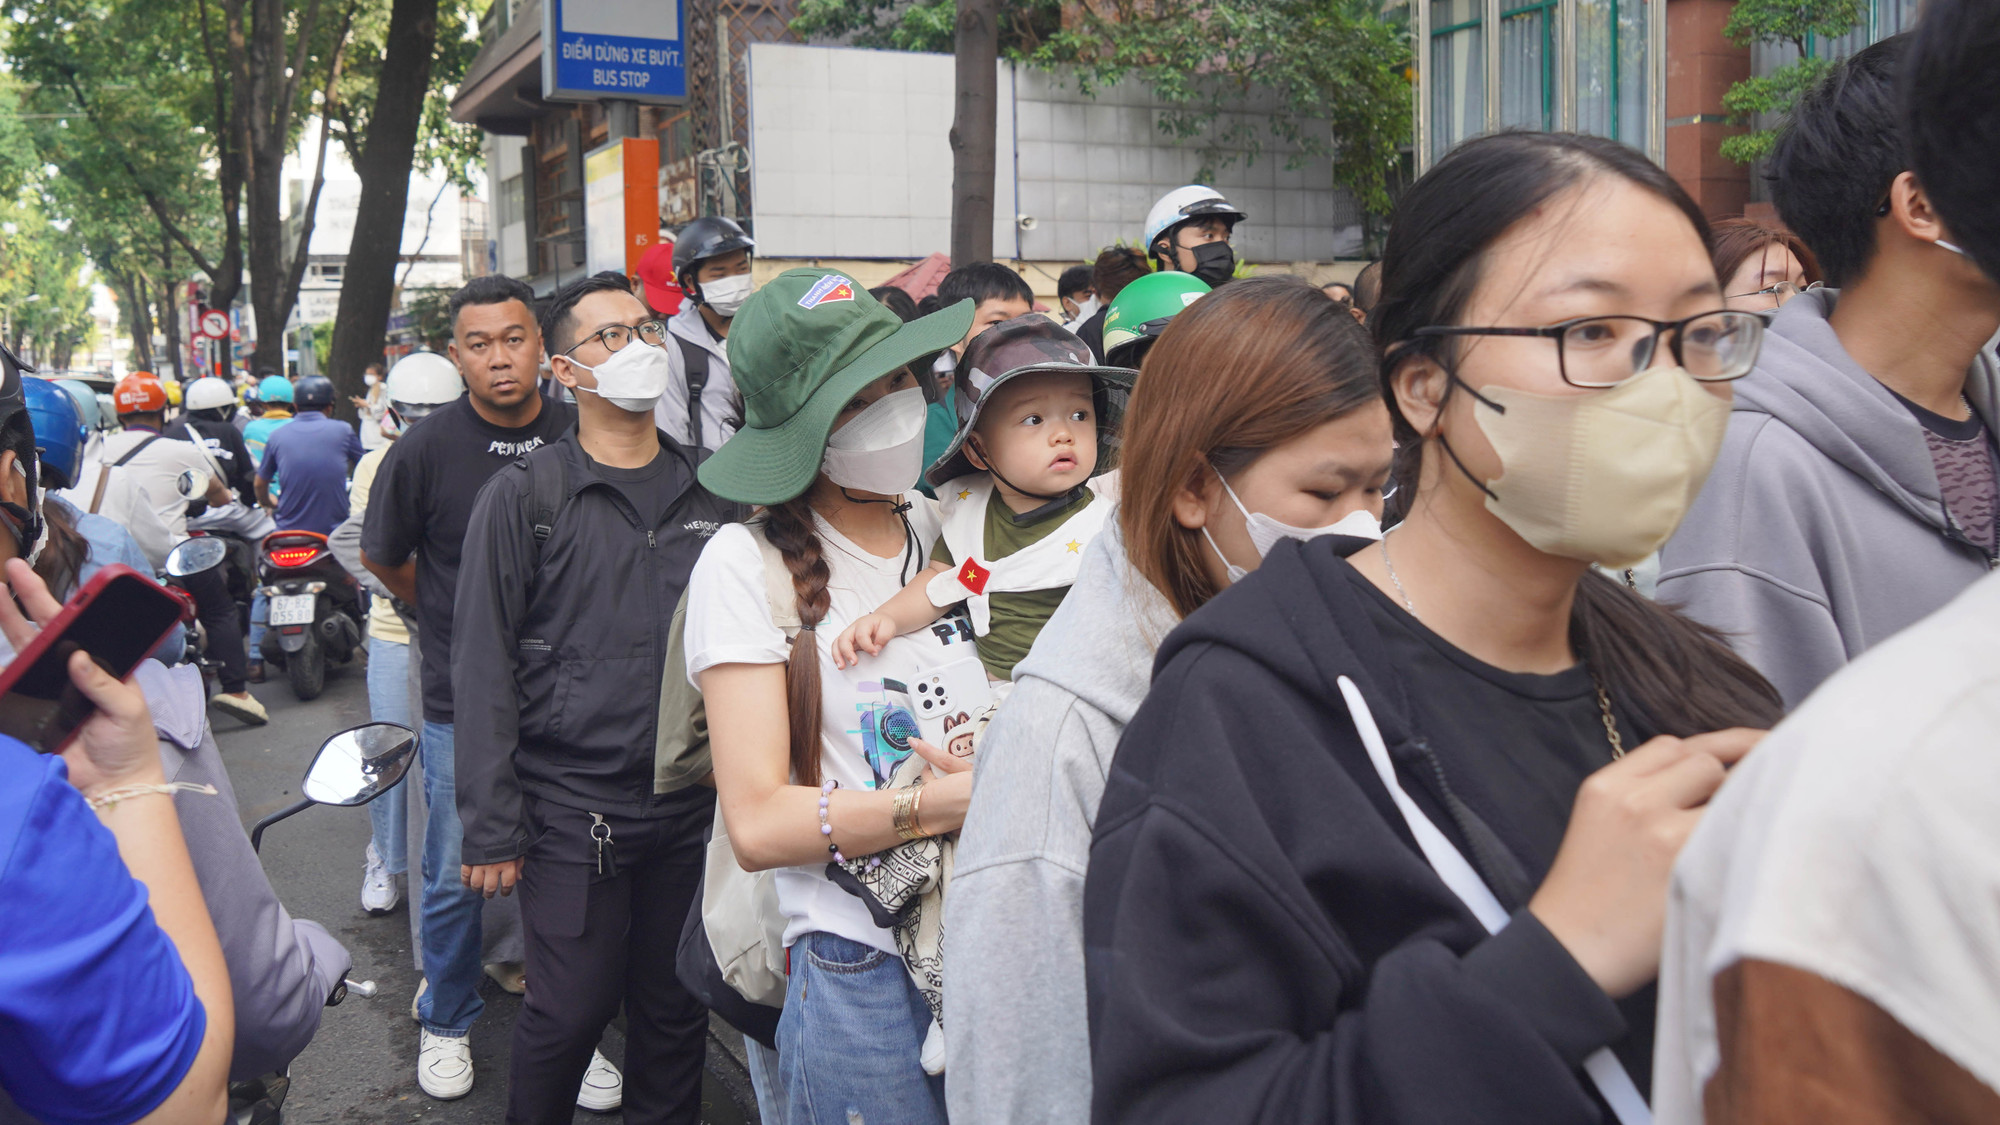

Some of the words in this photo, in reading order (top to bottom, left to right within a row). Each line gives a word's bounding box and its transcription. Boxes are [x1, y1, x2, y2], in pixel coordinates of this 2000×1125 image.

[562, 37, 592, 60] ĐIỂM
[595, 41, 630, 63] DỪNG
[631, 48, 647, 65] XE
[649, 47, 679, 67] BUÝT
[593, 69, 617, 86] BUS
[619, 71, 650, 88] STOP
[804, 288, 824, 305] THANH
[683, 520, 719, 531] HEROIC
